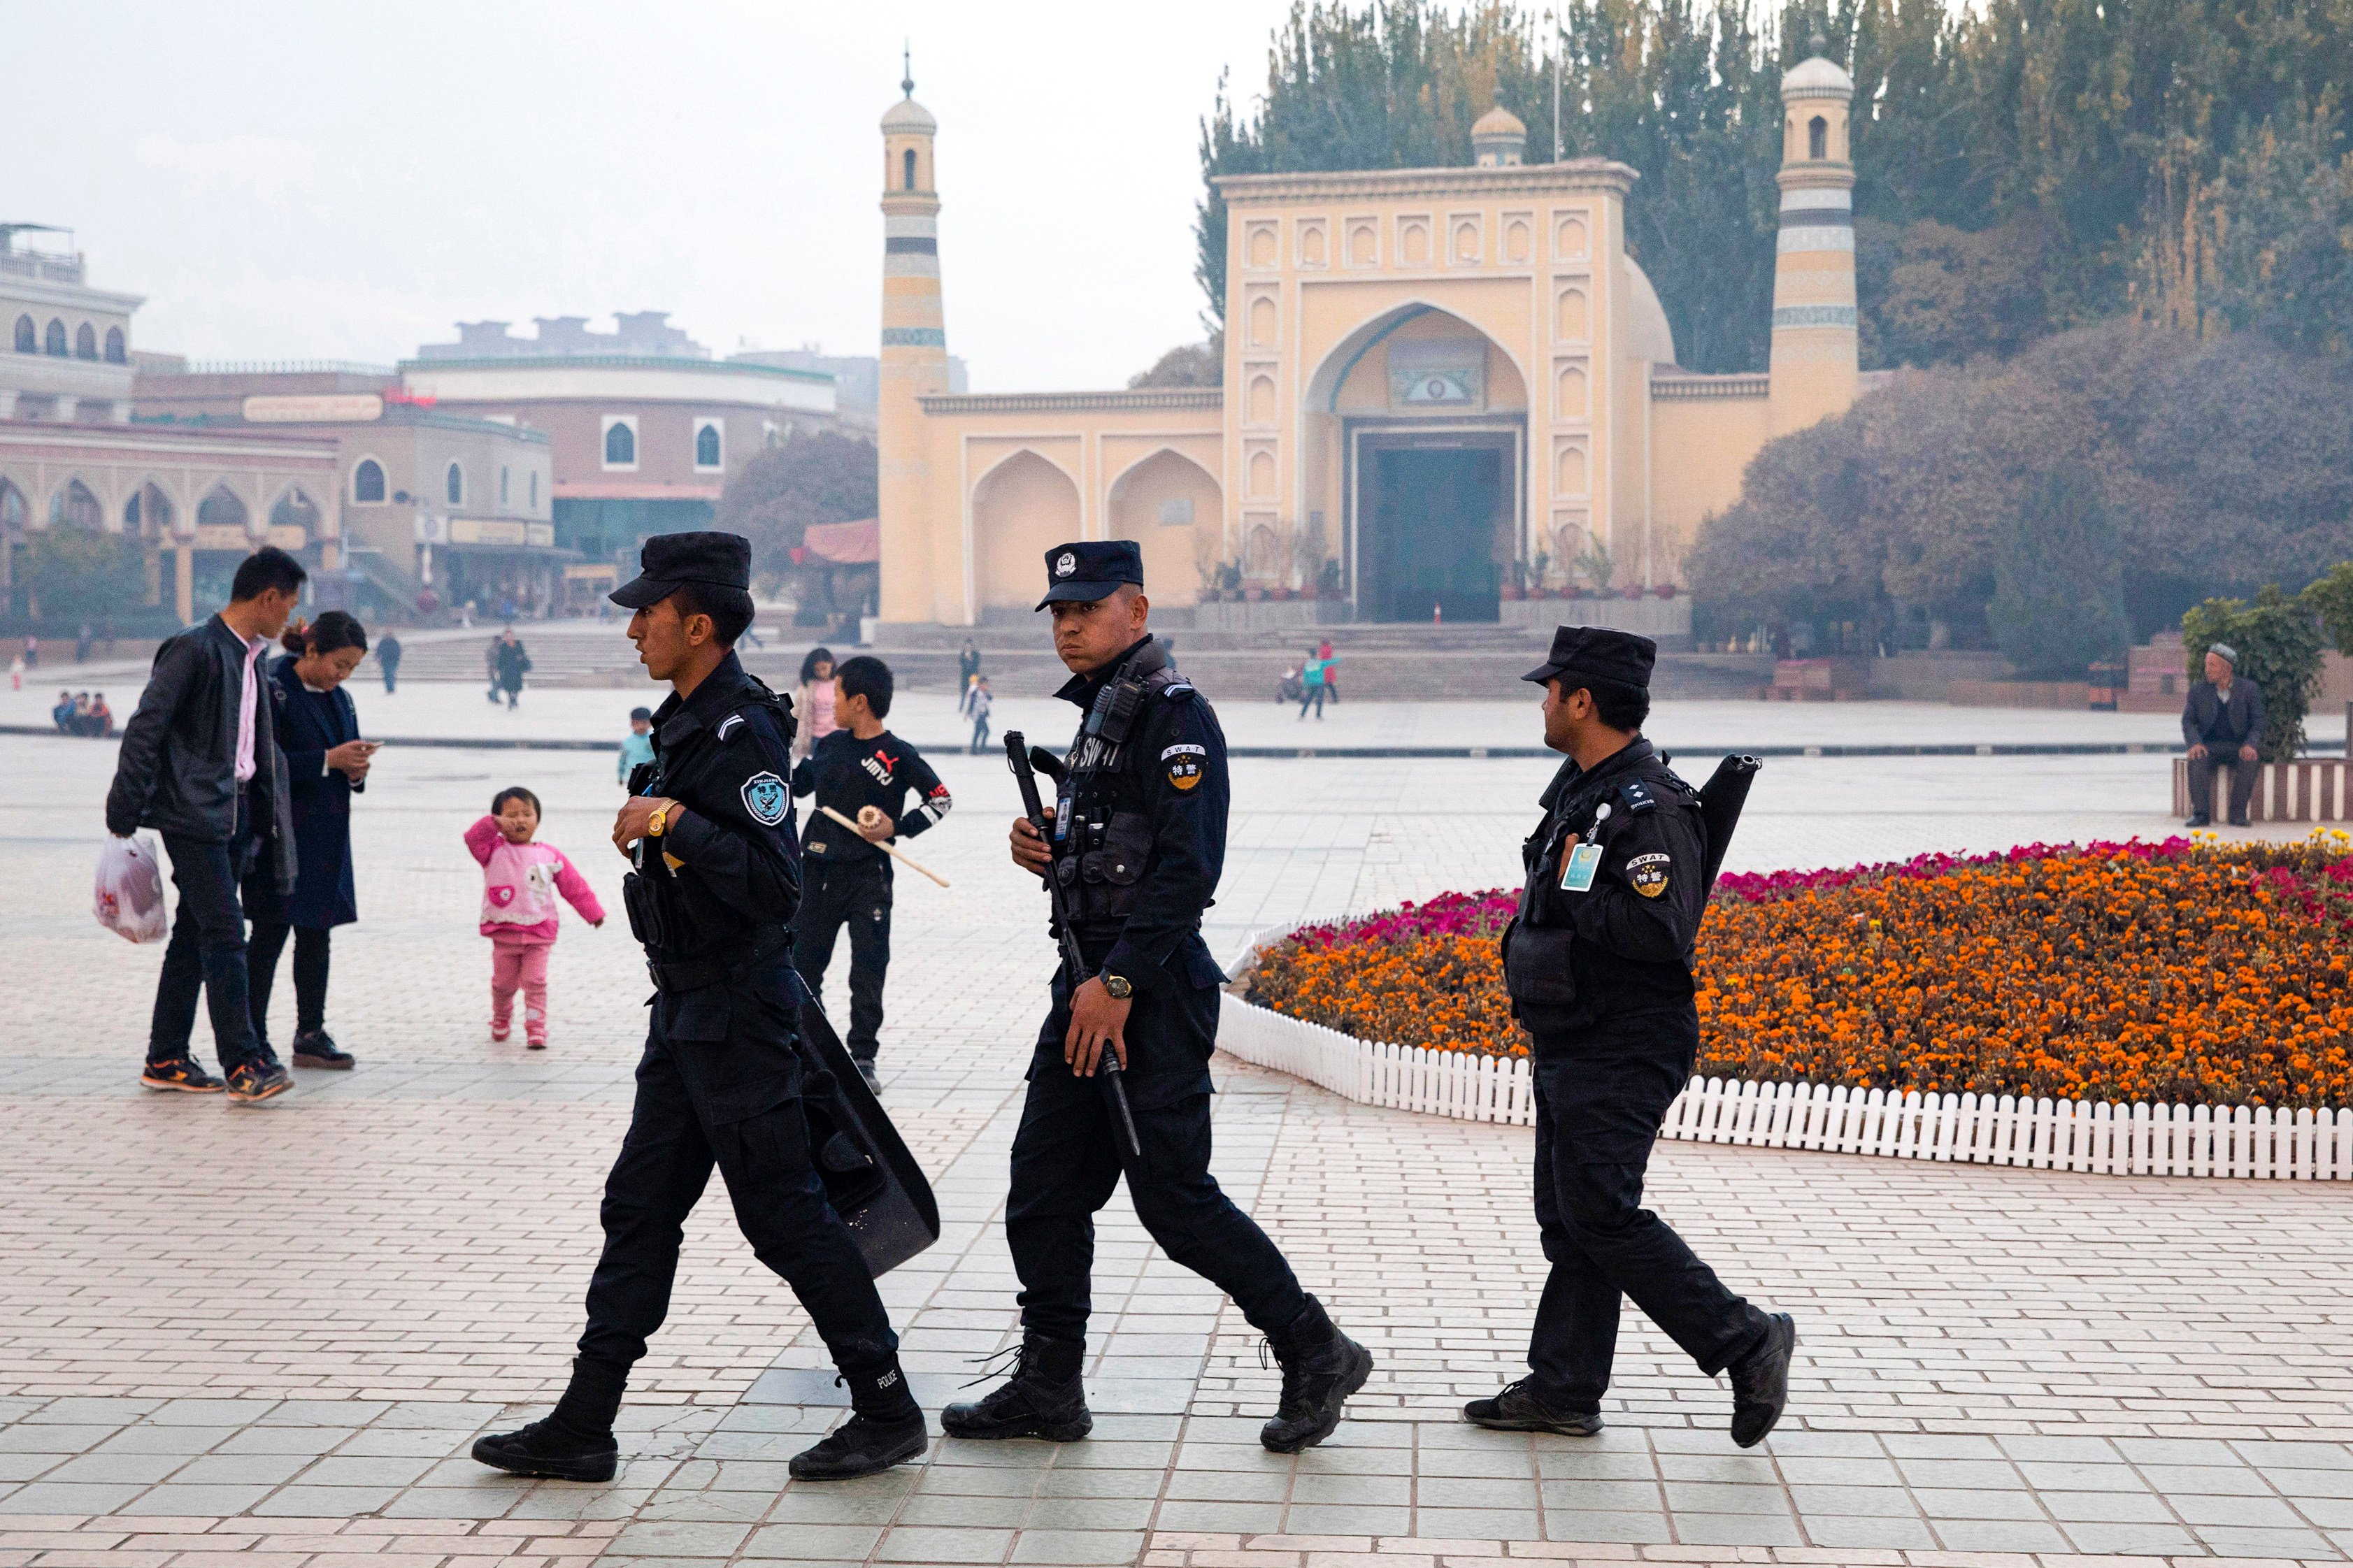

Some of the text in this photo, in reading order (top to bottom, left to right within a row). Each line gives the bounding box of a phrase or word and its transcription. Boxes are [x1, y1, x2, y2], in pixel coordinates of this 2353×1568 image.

[1166, 745, 1199, 756] SWAT
[1172, 763, 1196, 776] 特警
[1631, 854, 1665, 866] SWAT
[1636, 871, 1661, 883] 特警
[877, 1369, 897, 1389] POLICE
